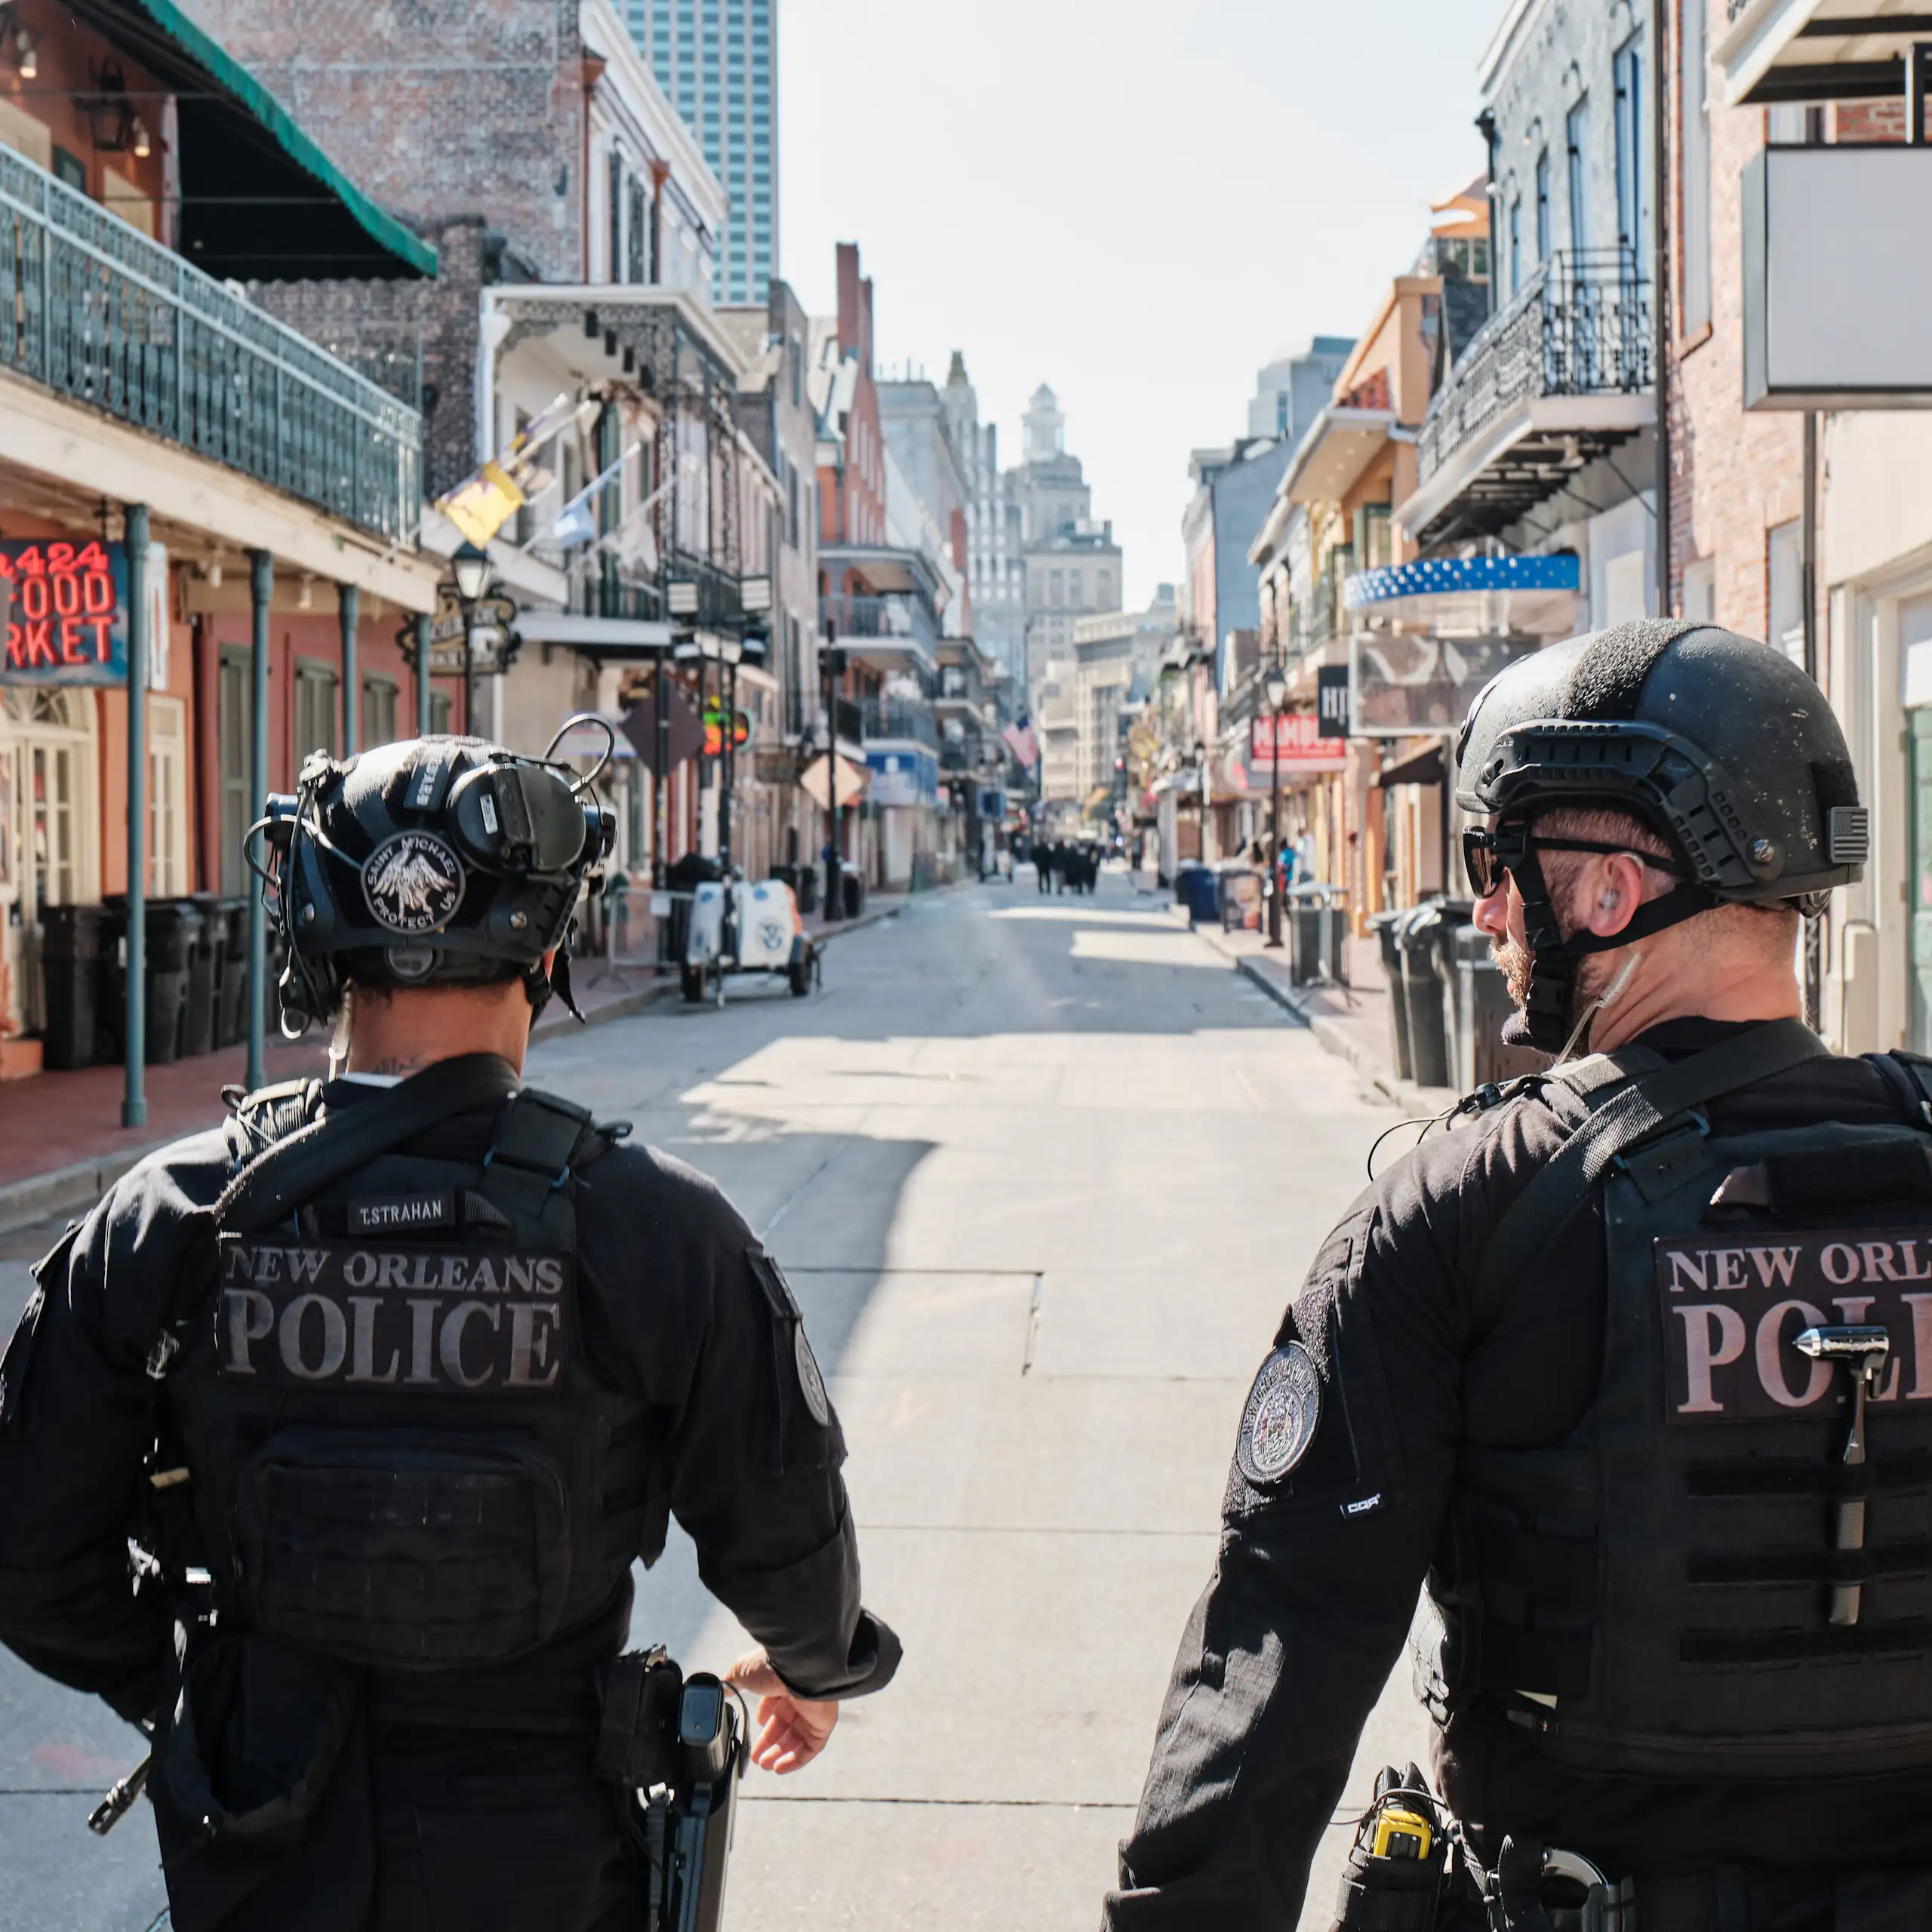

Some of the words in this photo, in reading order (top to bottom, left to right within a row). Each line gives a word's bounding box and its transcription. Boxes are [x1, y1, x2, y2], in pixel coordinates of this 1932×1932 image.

[15, 541, 109, 575] 424
[10, 571, 115, 620] OOD
[367, 845, 392, 885] SAINT
[400, 835, 456, 878] MICHAEL
[374, 896, 434, 930] PROTECT
[439, 891, 456, 912] US
[360, 1199, 442, 1226] T.STRAHAN
[225, 1246, 331, 1283] NEW
[343, 1251, 563, 1294] ORLEANS
[1666, 1246, 1802, 1293] NEW
[1820, 1240, 1932, 1284] ORL
[224, 1287, 561, 1389] POLICE
